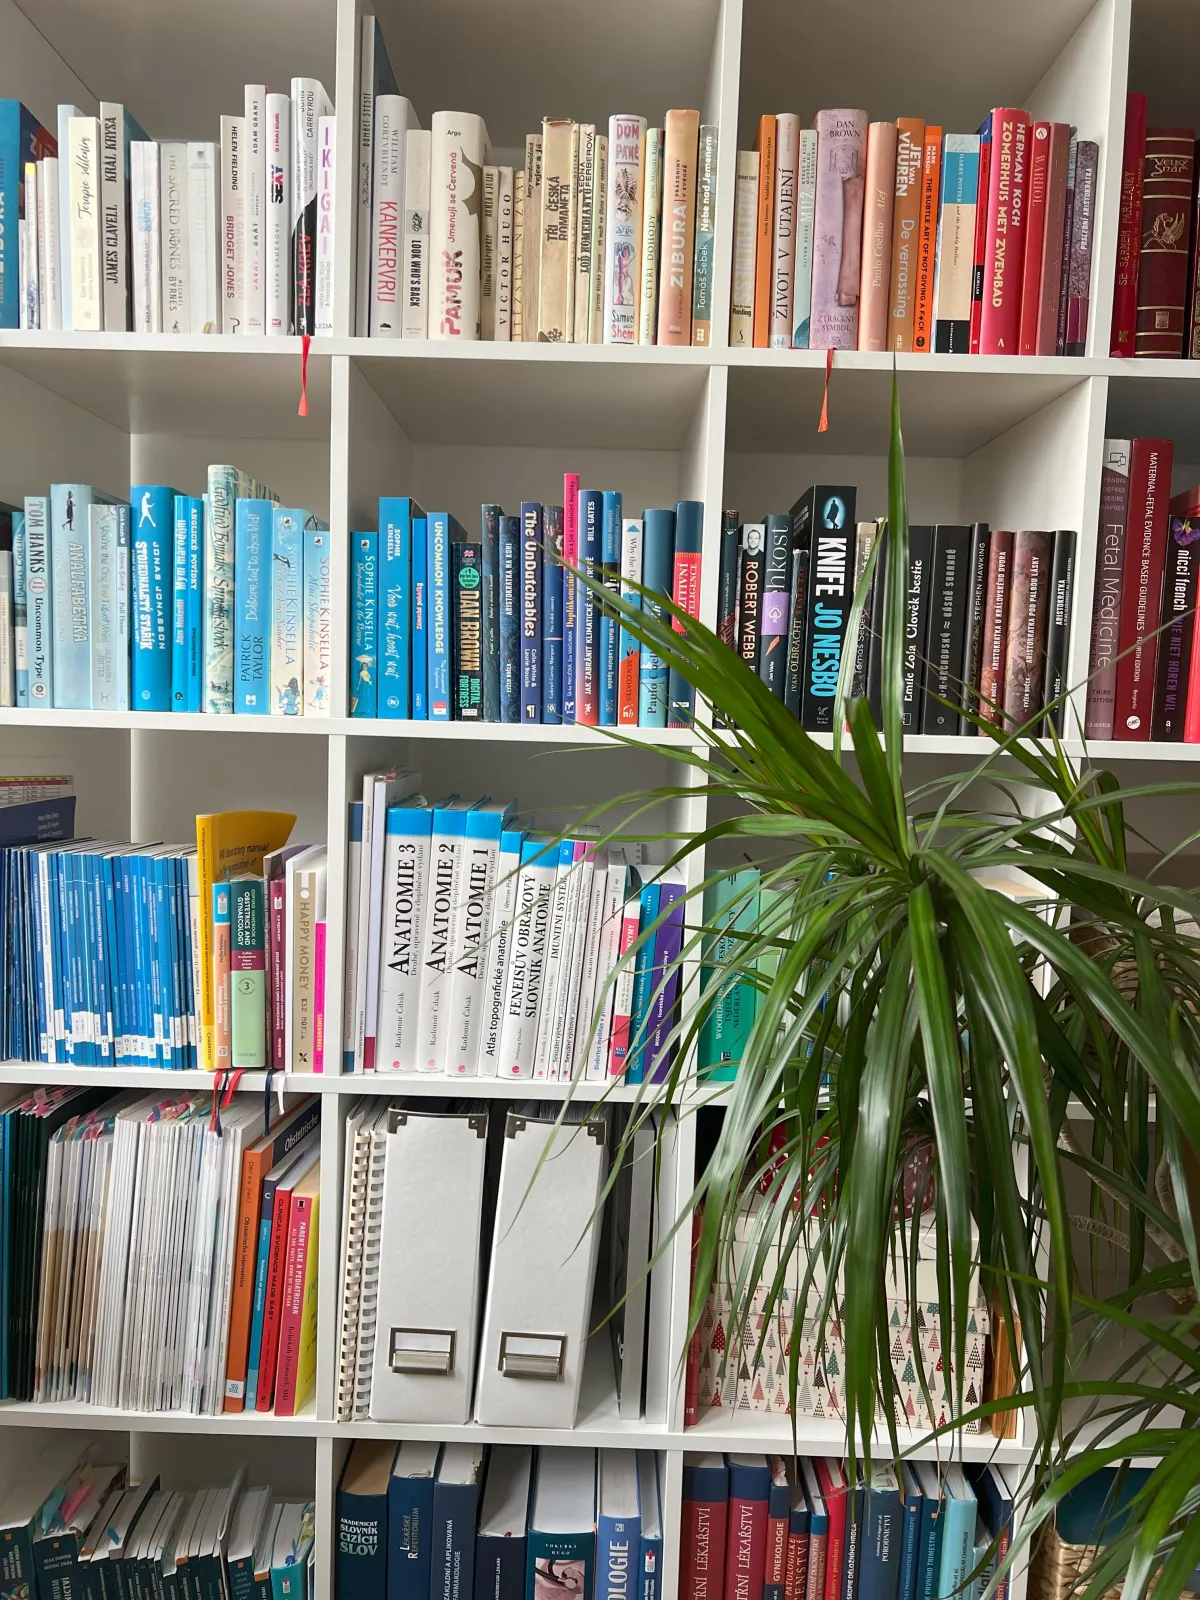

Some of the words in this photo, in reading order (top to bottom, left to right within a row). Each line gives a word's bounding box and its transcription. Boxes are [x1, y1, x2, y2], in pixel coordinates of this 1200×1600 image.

[252, 99, 260, 127] GRANT
[306, 90, 315, 139] CARREYROU
[103, 116, 117, 151] KRYSA
[76, 135, 91, 176] sdílením
[102, 153, 118, 183] KRÁL
[445, 151, 458, 191] Červená
[701, 135, 713, 186] Jemenem
[896, 131, 910, 197] VUUREN
[909, 143, 922, 167] JET
[956, 153, 965, 176] HARRY
[999, 121, 1013, 202] ZOMERHUIS
[1014, 123, 1026, 183] HERMAN
[231, 155, 239, 191] FIELDING
[908, 167, 916, 184] VAN
[925, 177, 933, 194] THE
[956, 177, 964, 203] POTTER
[1032, 154, 1046, 207] WARHOL
[76, 179, 94, 220] Terapie
[446, 193, 456, 204] se
[544, 175, 560, 212] ČESKÁ
[557, 183, 571, 241] ROMANETA
[700, 188, 711, 206] nad
[778, 168, 794, 238] UTAJENÍ
[924, 195, 932, 225] SUBTLE
[1011, 188, 1022, 226] KOCH
[104, 204, 119, 247] CLAVELL
[226, 215, 236, 261] BRIDGET
[446, 207, 458, 244] Jmenuji
[500, 193, 512, 245] HUGO
[546, 223, 559, 242] TŘI
[646, 213, 657, 262] DOHODY
[700, 207, 711, 232] Nebe
[901, 219, 915, 240] De
[923, 226, 931, 242] ART
[996, 206, 1008, 234] MET
[298, 231, 312, 274] KREV
[377, 201, 398, 303] KANKERVRIJ
[409, 239, 422, 259] LOOK
[670, 204, 687, 287] ZIBURA
[696, 243, 709, 274] Šebek
[778, 248, 791, 260] V
[922, 244, 930, 255] OF
[105, 250, 119, 284] JAMES
[226, 263, 235, 299] JONES
[409, 260, 422, 285] WHO'S
[642, 266, 654, 299] ČTYŘI
[893, 244, 911, 319] verrassing
[992, 238, 1006, 308] ZWEMBAD
[296, 277, 311, 307] ZLÁ
[409, 286, 421, 307] BACK
[440, 249, 463, 335] PAMUK
[498, 255, 510, 325] VICTOR
[696, 277, 708, 310] Tomáš
[772, 268, 790, 319] ŽIVOT
[919, 274, 928, 301] GIVING
[1144, 452, 1159, 519] MATERNAL-FETAL
[27, 500, 45, 529] TOM
[525, 510, 537, 537] The
[587, 501, 595, 524] GATES
[29, 532, 45, 574] HANKS
[387, 523, 395, 562] KINSELLA
[587, 527, 595, 542] BILL
[1103, 523, 1123, 571] Fetal
[1141, 520, 1154, 558] EVIDENCE
[152, 541, 161, 581] JONAS
[434, 521, 444, 587] UNCOMMON
[815, 537, 847, 596] KNIFE
[975, 542, 986, 582] HAWKING
[1029, 556, 1040, 577] LÁSKY
[1140, 559, 1150, 585] BASED
[1176, 549, 1190, 576] nicci
[135, 541, 151, 612] STOJEDNALETÝ
[524, 541, 537, 637] UnDutchables
[744, 561, 759, 616] ROBERT
[1029, 578, 1038, 602] PALBOU
[1172, 578, 1189, 611] french
[155, 586, 165, 650] JONASSON
[434, 589, 445, 654] KNOWLEDGE
[459, 590, 480, 618] DAN
[813, 602, 842, 628] JO
[974, 584, 983, 621] STEPHEN
[1028, 603, 1037, 617] POD
[1136, 586, 1148, 631] GUIDELINES
[33, 597, 45, 653] Uncommon
[138, 614, 154, 650] STAŘÍK
[583, 602, 595, 644] KLIMATICKÉ
[742, 620, 757, 659] WEBB
[1025, 618, 1036, 664] ARISTOKRATKA
[1096, 577, 1120, 668] Medicine
[240, 634, 251, 682] PATRICK
[254, 636, 264, 682] TAYLOR
[459, 621, 480, 671] BROWN
[582, 645, 594, 680] ZABRÁNIT
[34, 655, 45, 679] Type
[458, 675, 470, 708] FORTRESS
[470, 678, 480, 705] DIGITAL
[584, 681, 593, 696] JAK
[398, 843, 416, 853] 3
[243, 891, 251, 930] OBSTETRICS
[299, 902, 309, 942] HAPPY
[387, 859, 415, 976] ANATOMIE
[424, 858, 447, 974] ANATOMIE
[440, 843, 456, 853] 2
[456, 862, 488, 979] ANATOMIE
[517, 874, 535, 948] OBRAZOVÝ
[532, 883, 551, 956] ANATOMIE
[494, 920, 508, 967] anatomie
[550, 914, 563, 959] IMUNITNÍ
[299, 944, 309, 991] MONEY
[509, 950, 528, 1017] FENEISŮV
[488, 967, 504, 1030] topografické
[525, 960, 543, 1018] SLOVNÍK
[485, 1031, 498, 1057] Atlas
[240, 1216, 250, 1253] Obstetrische
[275, 1198, 284, 1233] CLINICAL
[297, 1221, 307, 1247] PARENT
[271, 1234, 281, 1273] EVIDENCE
[296, 1248, 305, 1262] LIKE
[270, 1274, 278, 1299] MADE
[292, 1270, 303, 1315] PEDIATRICIAN
[267, 1299, 275, 1321] EASY
[340, 1517, 379, 1527] AKADEMICKÝ
[340, 1523, 378, 1535] SLOVNÍK
[340, 1532, 378, 1544] CIZÍCH
[400, 1514, 411, 1551] LÉKAŘSKÉ
[407, 1507, 419, 1559] REPETITORIUM
[445, 1519, 453, 1561] APLIKOVANÁ
[695, 1508, 711, 1571] LÉKAŘSTVÍ
[736, 1505, 753, 1569] LÉKAŘSTVÍ
[881, 1514, 891, 1562] PORODNICTVÍ
[339, 1542, 378, 1556] SLOV
[773, 1522, 784, 1582] GYNEKOLOGIE
[927, 1531, 936, 1566] TRIMESTRU
